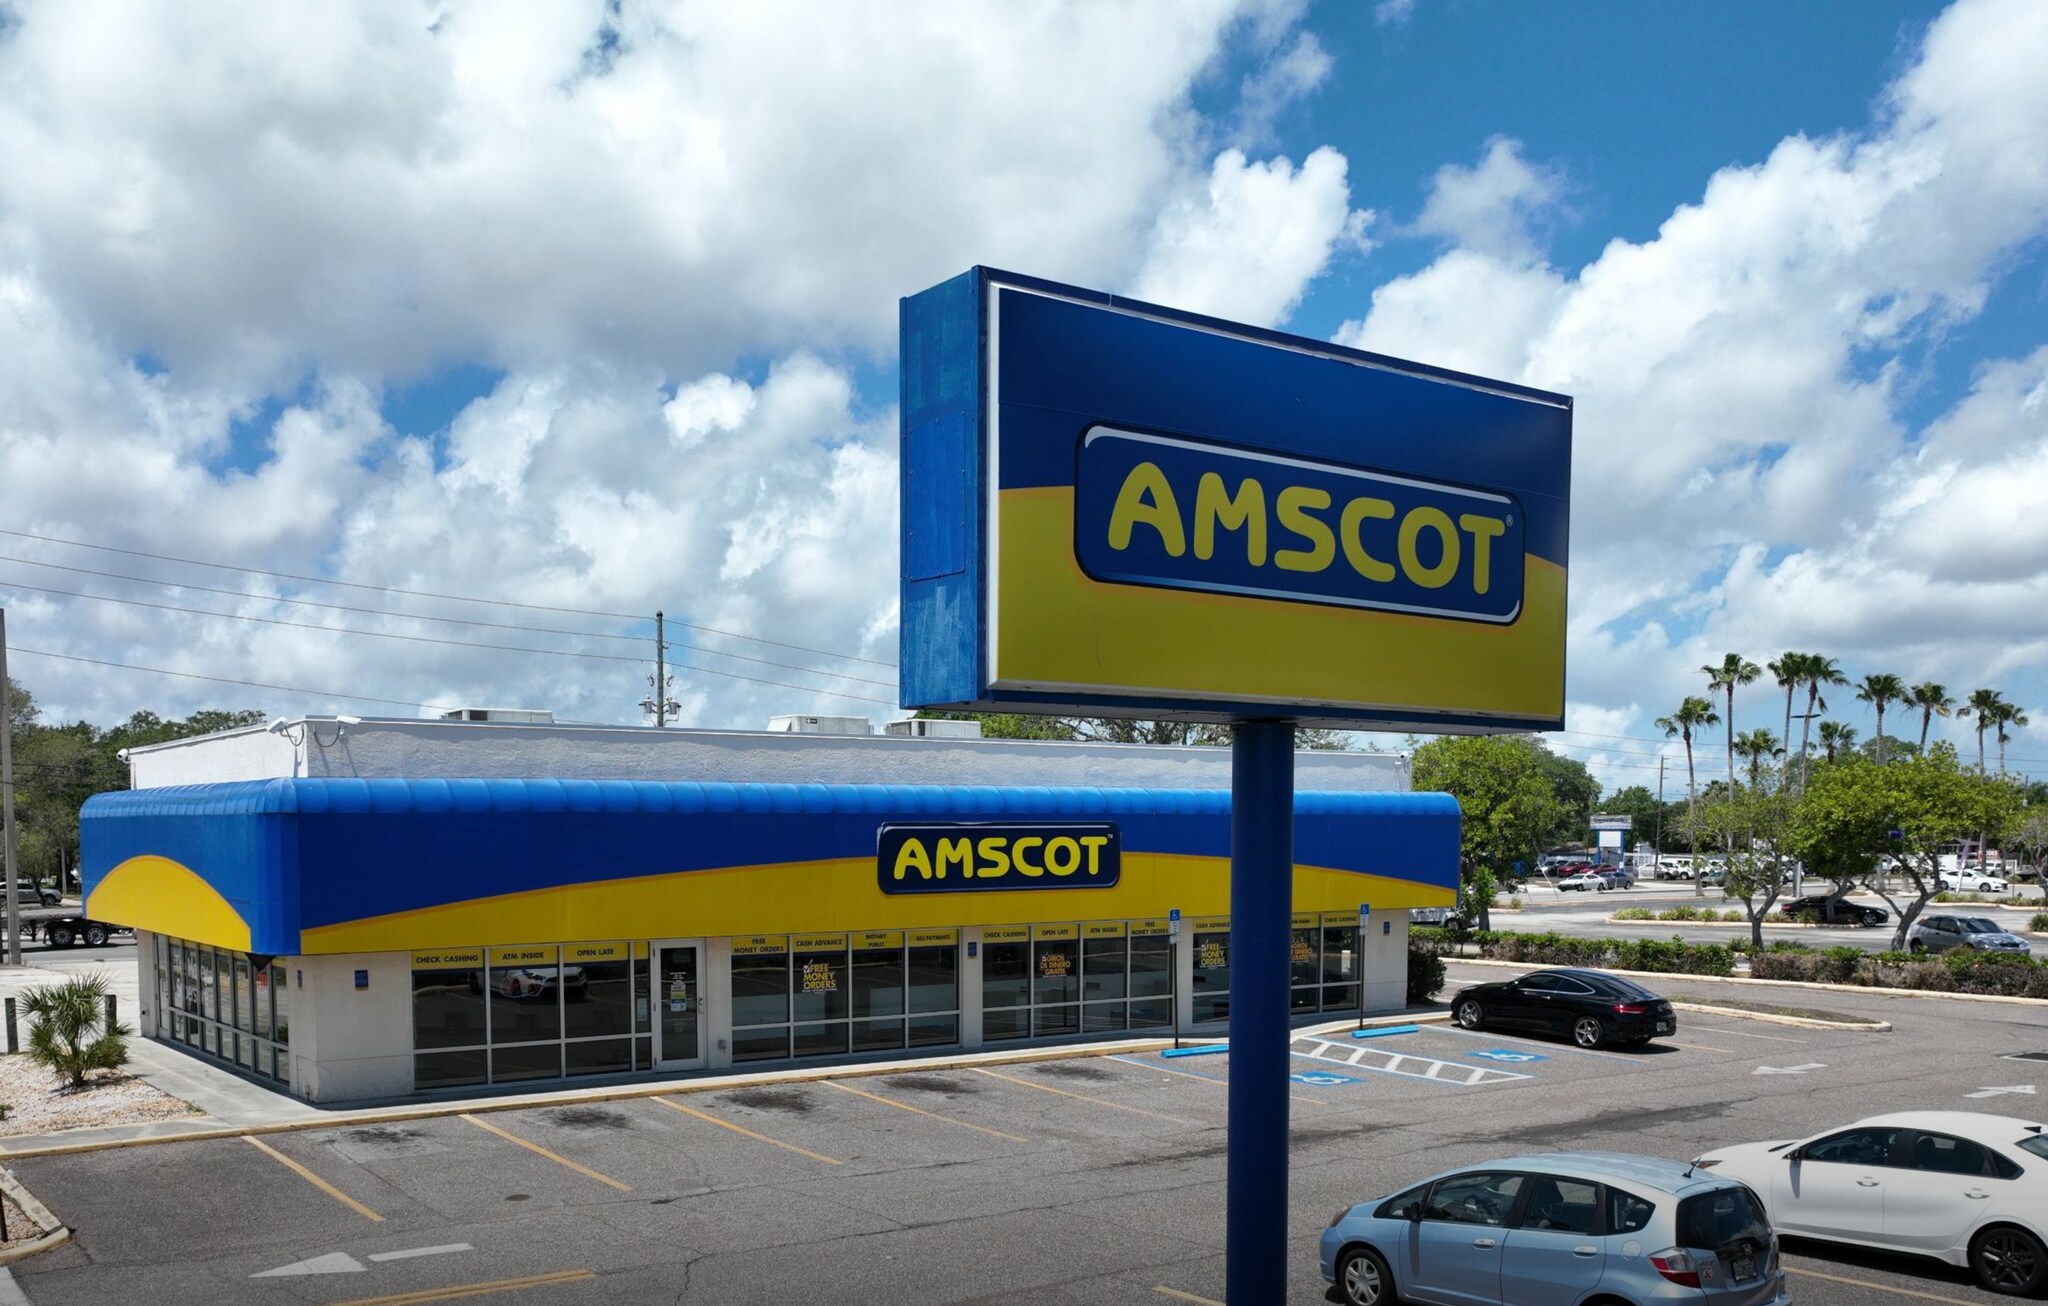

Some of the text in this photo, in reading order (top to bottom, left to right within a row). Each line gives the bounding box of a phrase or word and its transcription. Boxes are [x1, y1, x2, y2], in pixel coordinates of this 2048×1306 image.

[1107, 461, 1506, 594] AMSCOT
[893, 836, 1108, 880] AMSCOT
[984, 930, 1027, 939] CHECK CASHING
[520, 952, 544, 960] INSIDE
[598, 948, 614, 956] LATE
[1201, 950, 1225, 958] MONEY
[415, 954, 479, 964] CHECK CASHING
[810, 963, 829, 972] FREE
[803, 971, 834, 982] MONEY
[803, 981, 836, 990] ORDERS
